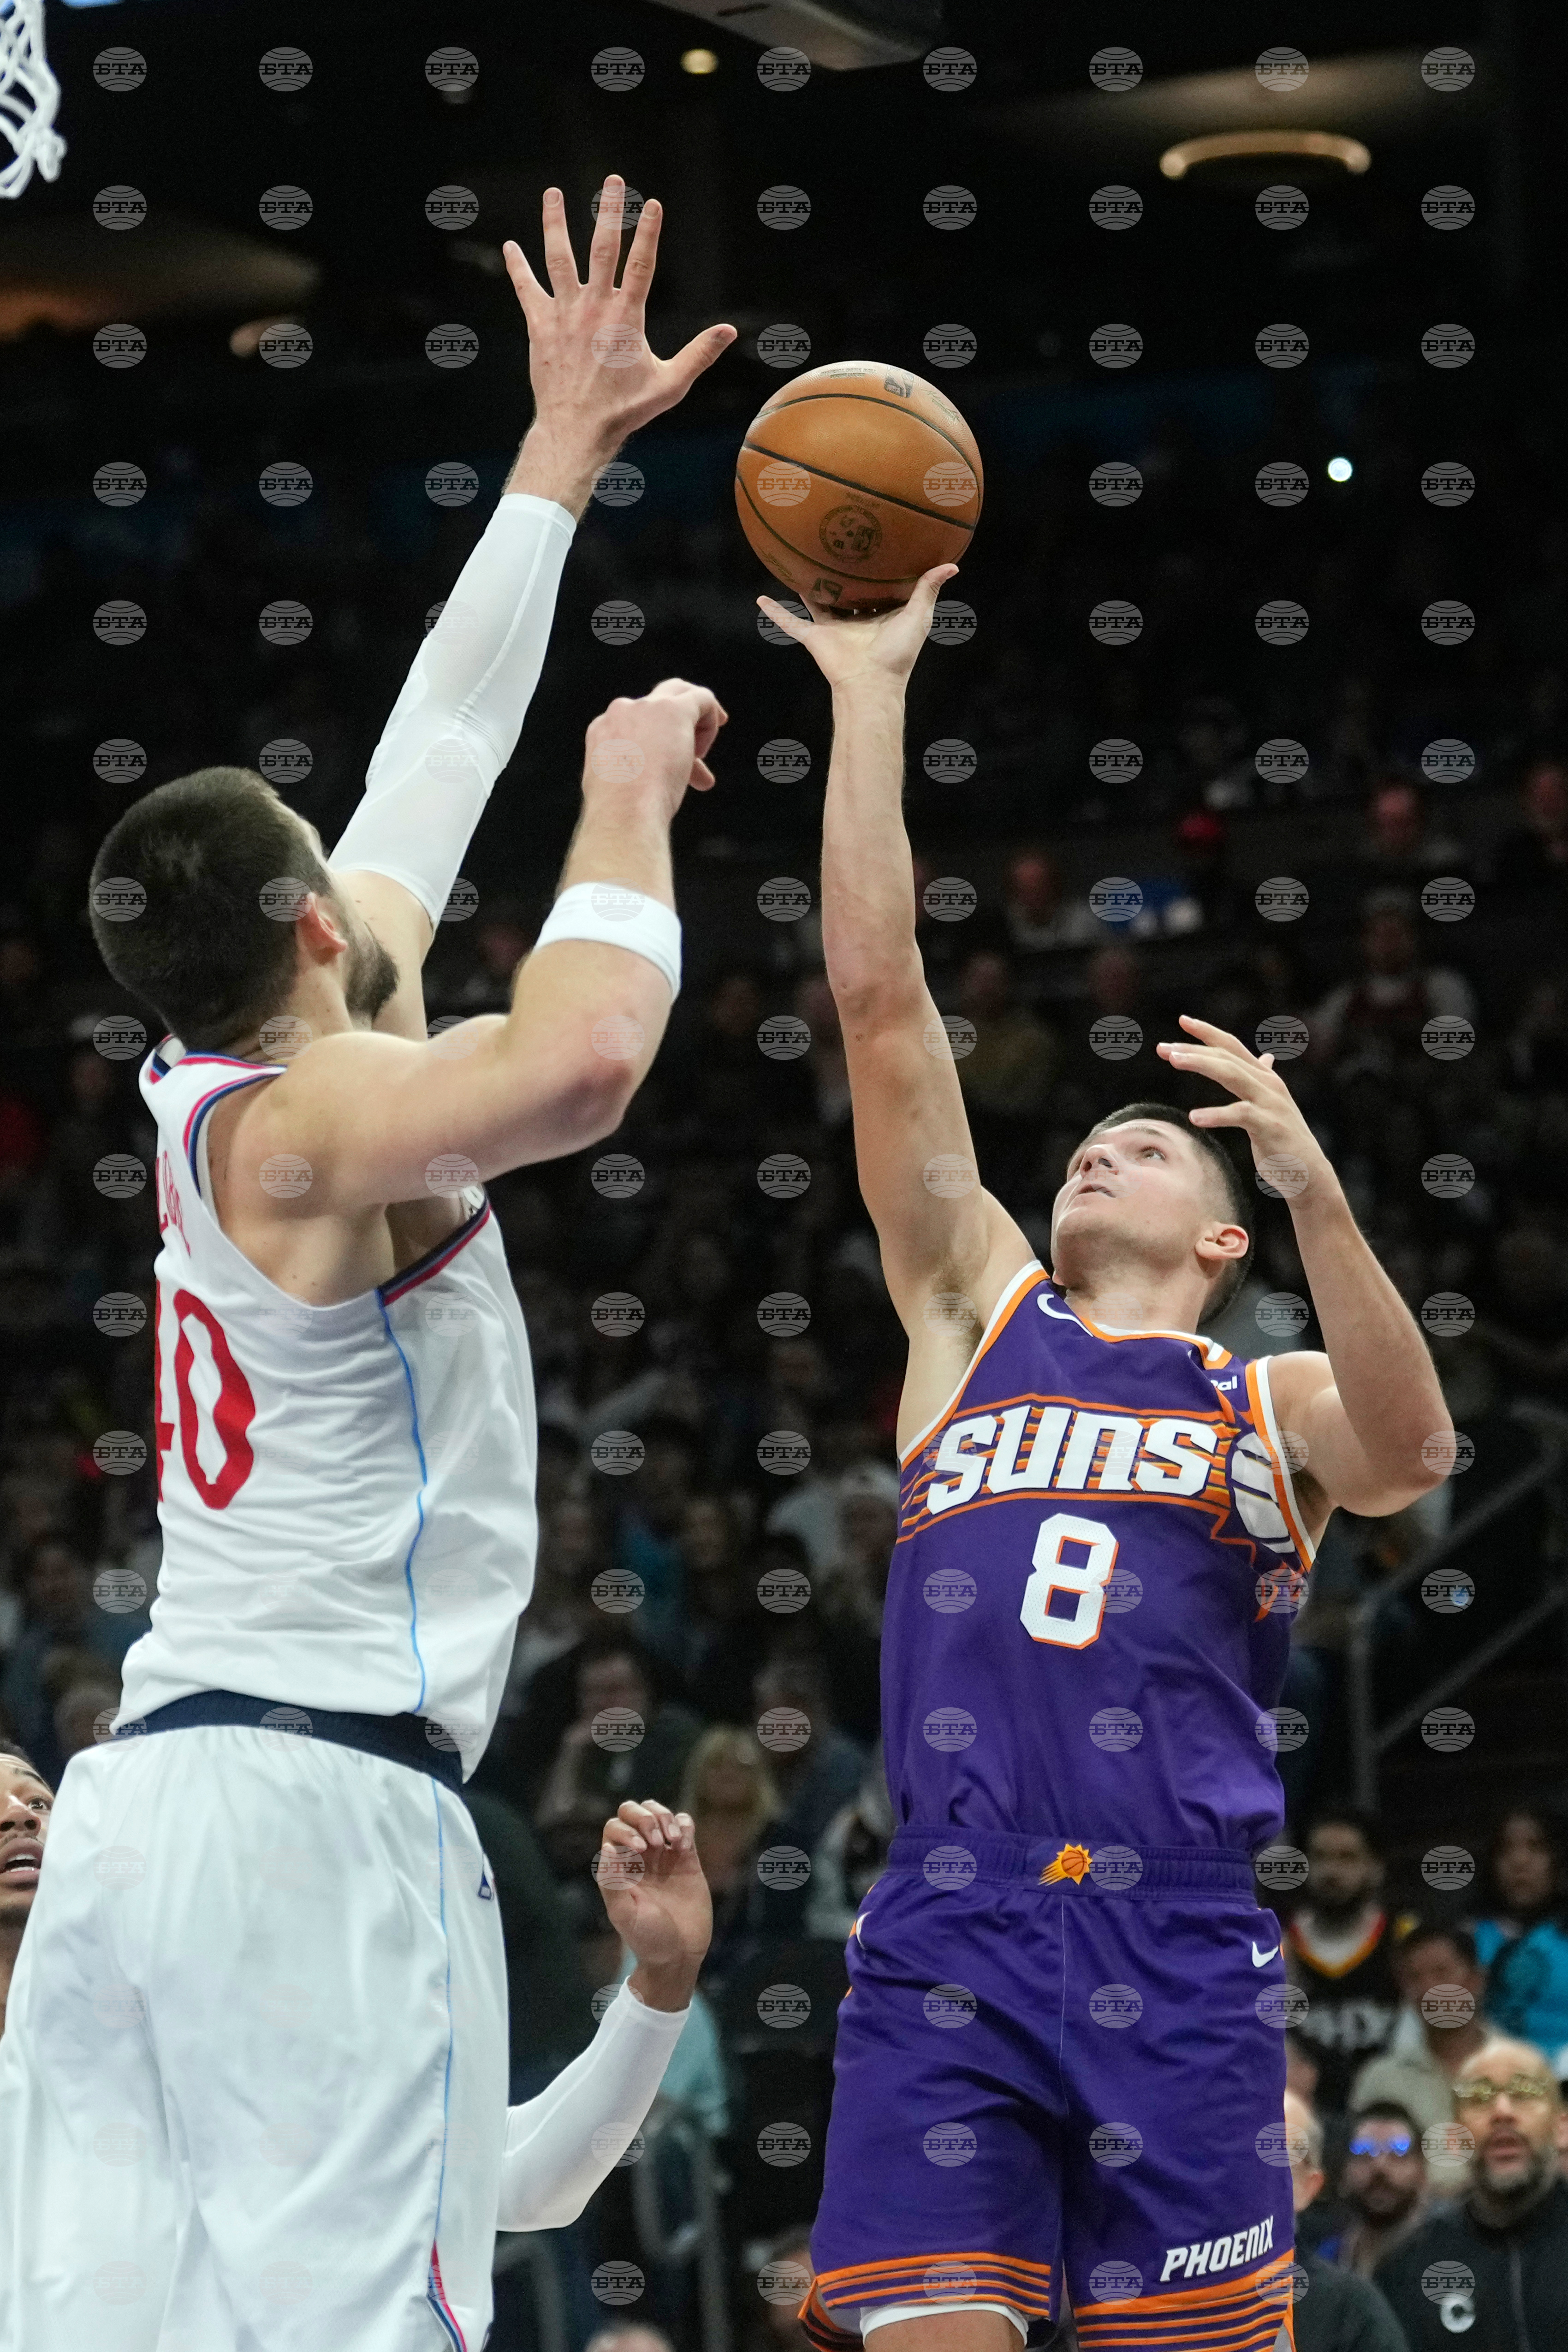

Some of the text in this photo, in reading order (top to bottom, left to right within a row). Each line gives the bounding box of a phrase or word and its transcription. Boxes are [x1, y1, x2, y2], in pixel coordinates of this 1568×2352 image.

[927, 1405, 1217, 1515] SUNS
[1020, 1513, 1119, 1650] 8
[1160, 2215, 1274, 2282] PHOENIX
